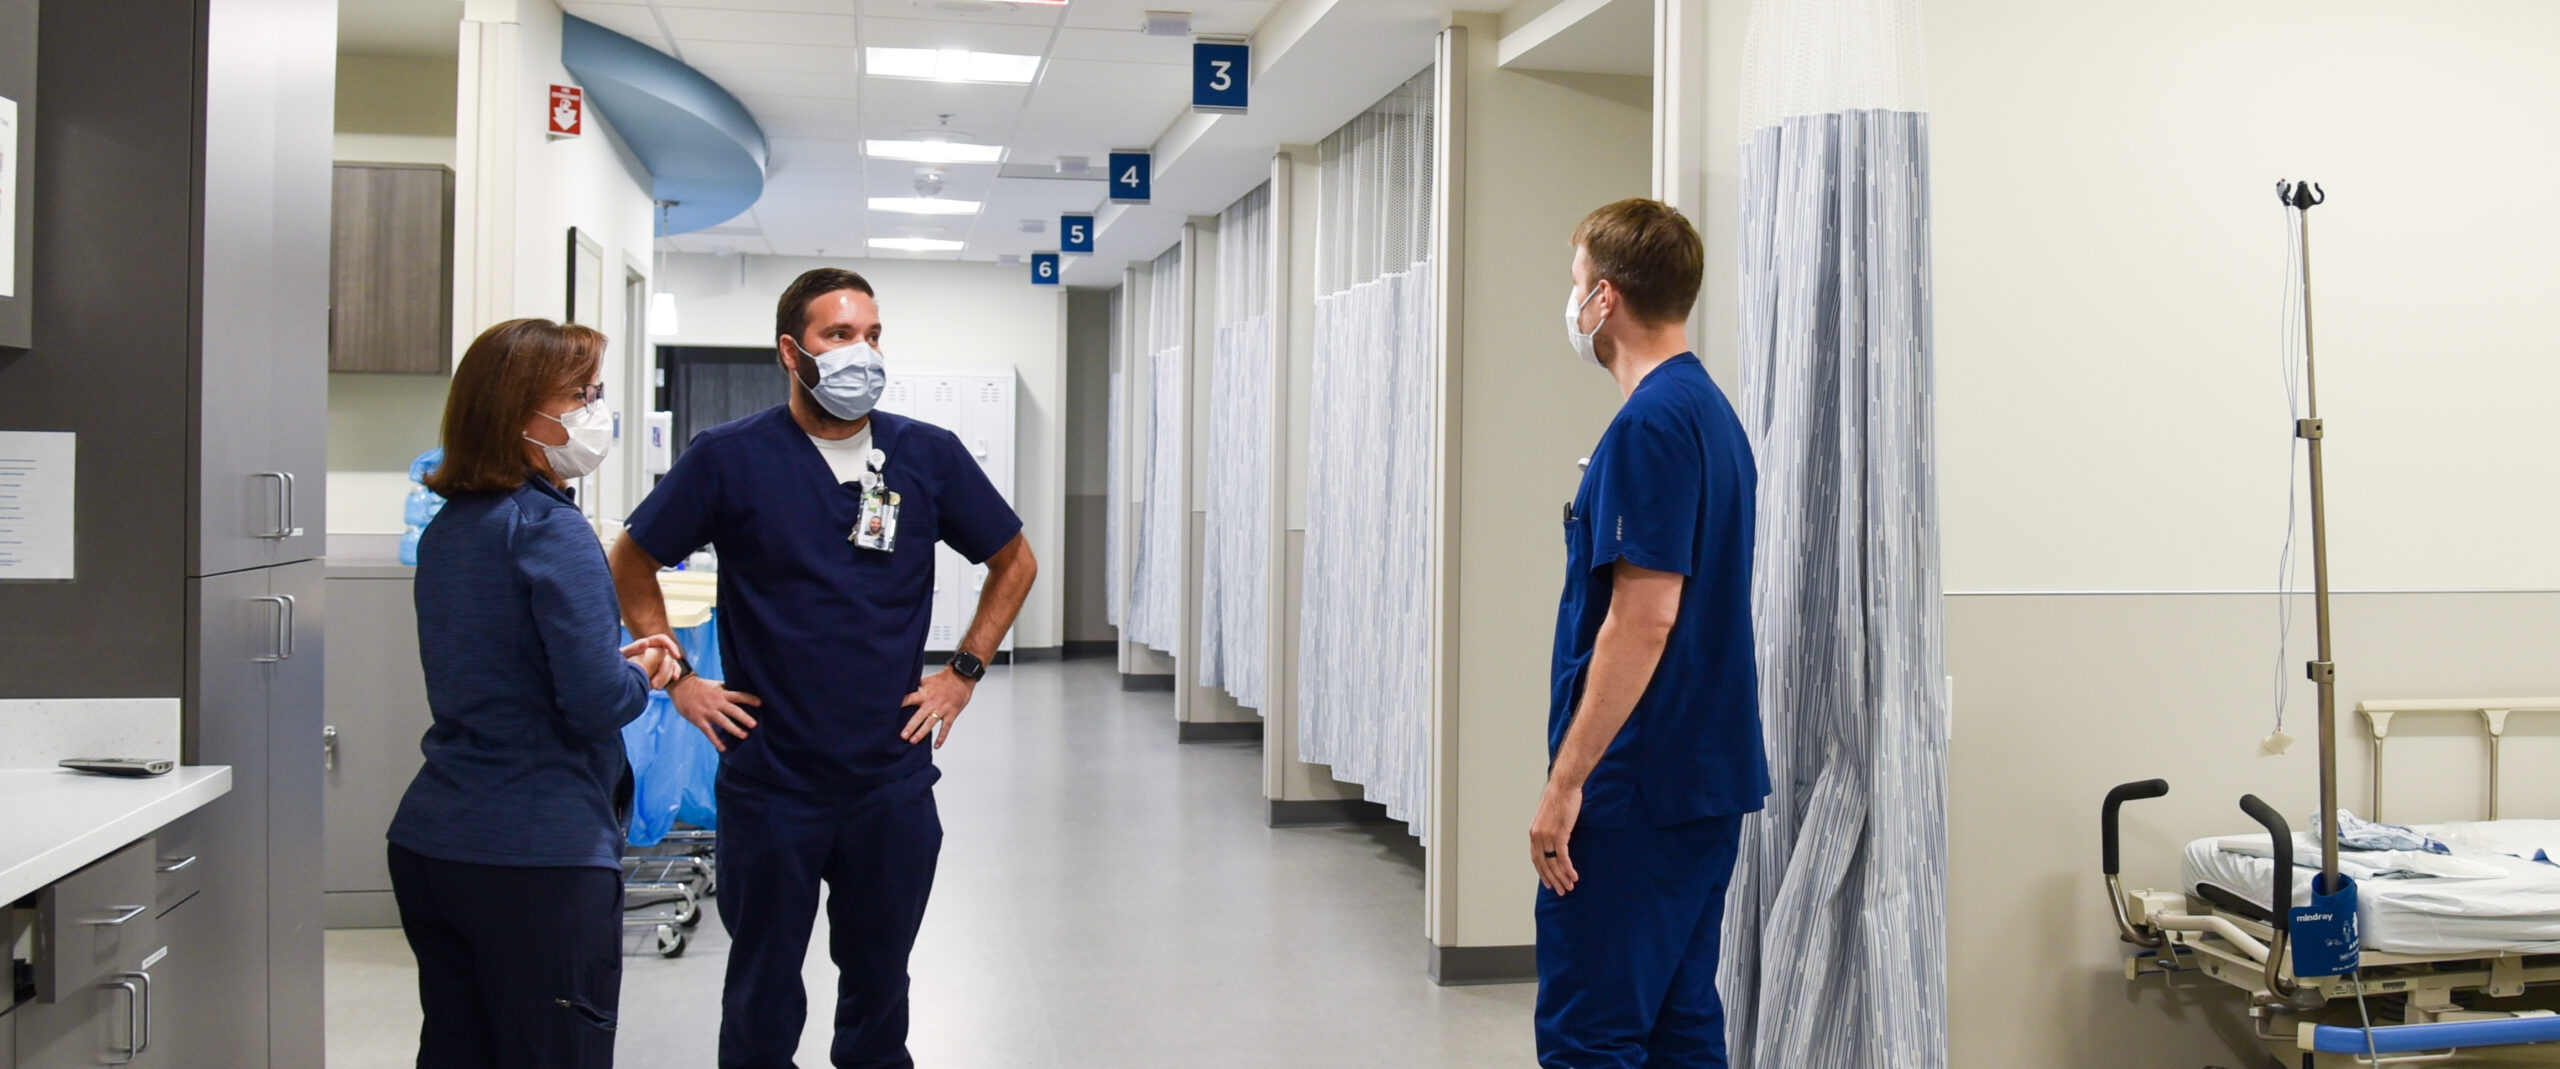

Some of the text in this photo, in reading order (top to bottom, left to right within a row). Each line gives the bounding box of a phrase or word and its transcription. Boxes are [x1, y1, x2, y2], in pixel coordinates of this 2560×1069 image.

[1209, 60, 1232, 91] 3
[1120, 165, 1140, 188] 4
[1070, 225, 1085, 244] 5
[1038, 261, 1052, 278] 6
[2296, 912, 2334, 922] mindray
